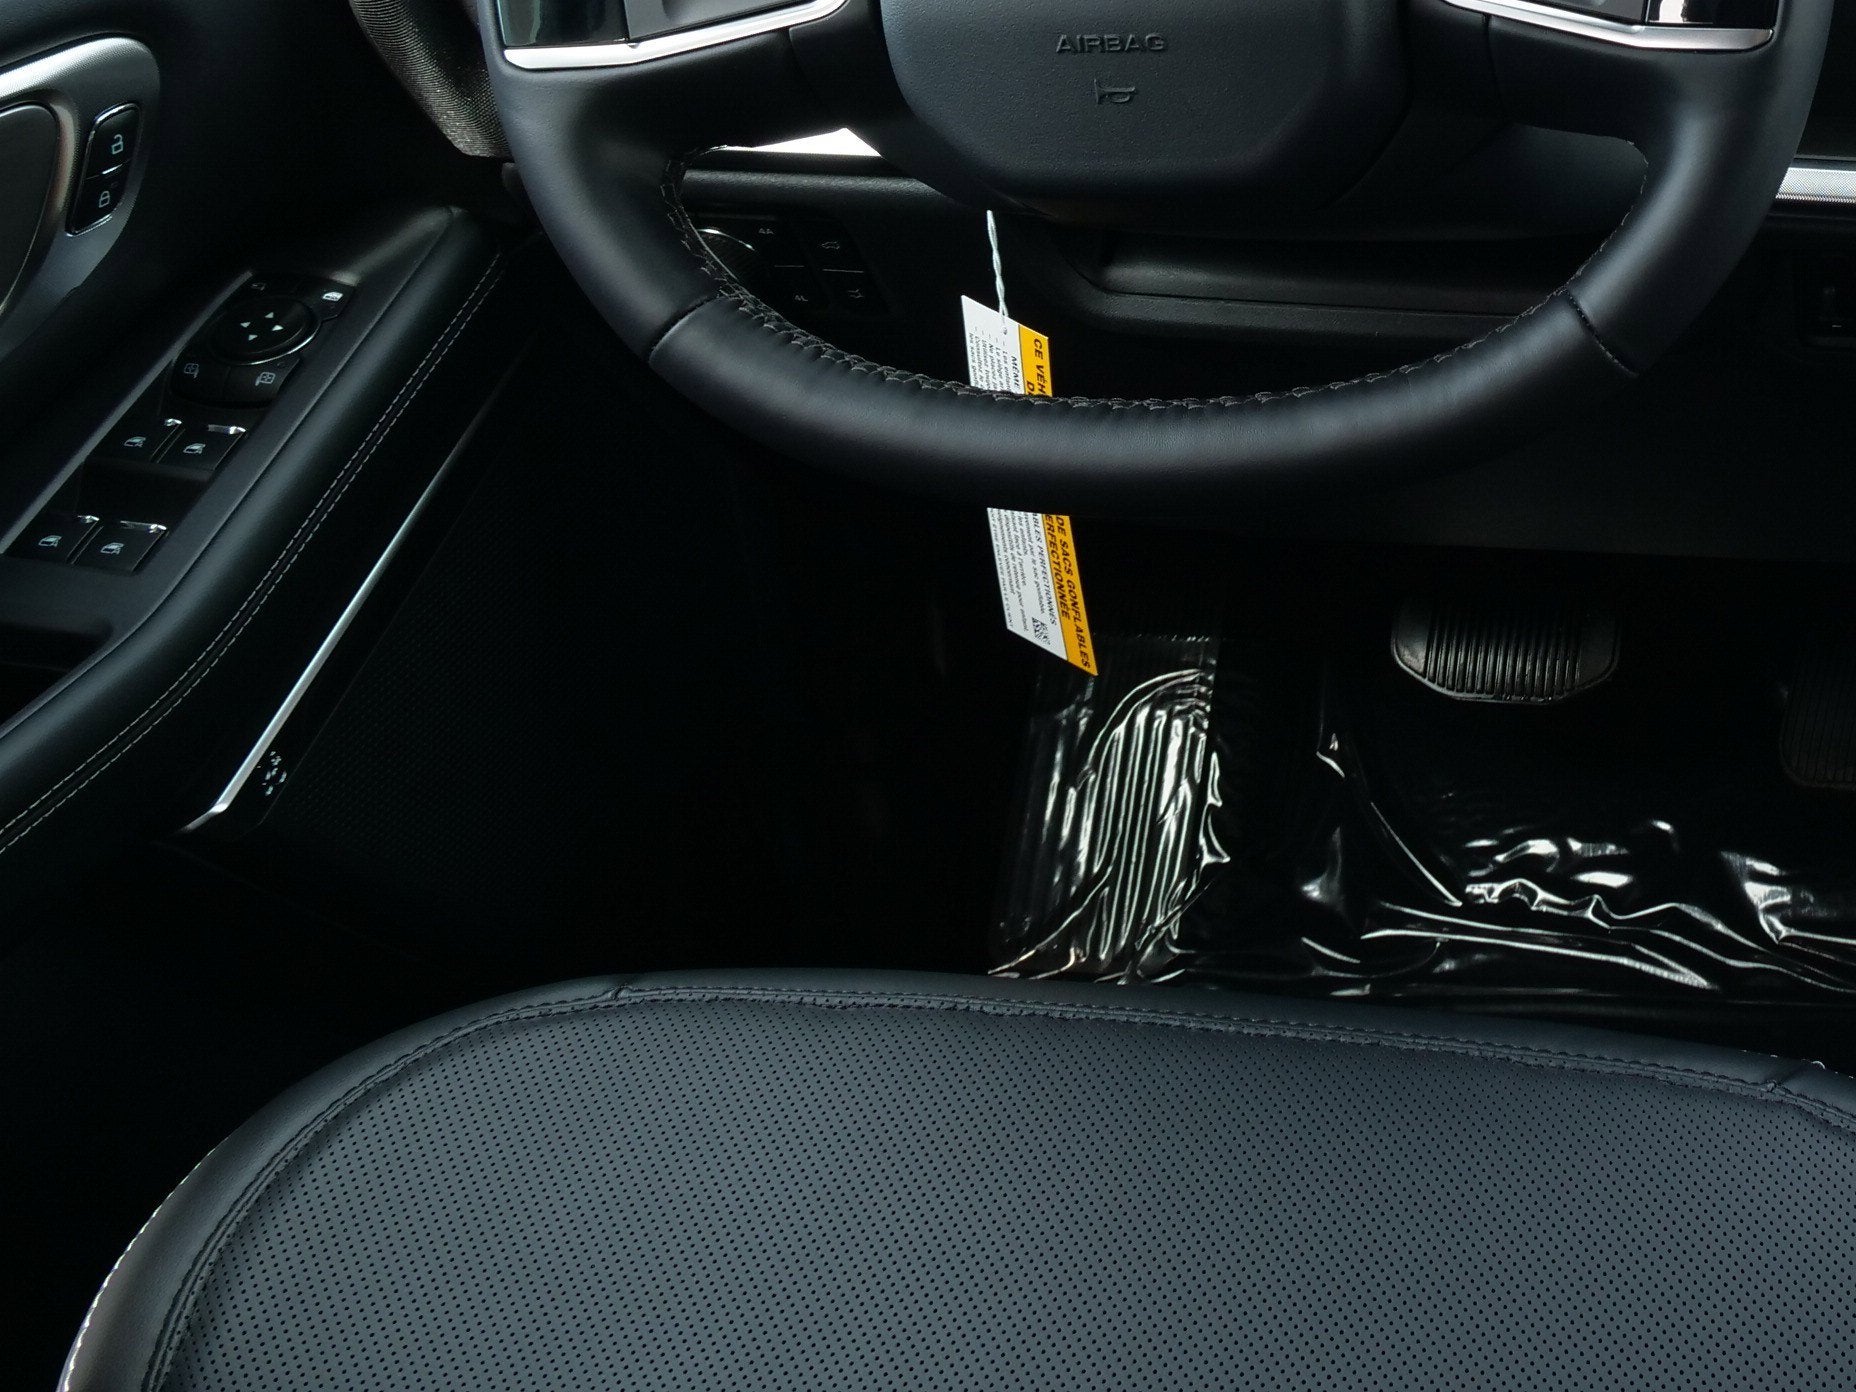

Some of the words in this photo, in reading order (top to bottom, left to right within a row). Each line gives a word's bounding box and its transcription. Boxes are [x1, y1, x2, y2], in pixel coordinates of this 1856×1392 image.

[1055, 33, 1168, 54] AIRBAG
[1034, 338, 1044, 360] CE
[1056, 516, 1067, 536] DE
[1060, 539, 1073, 576] SACS
[1066, 580, 1091, 669] GONFLABLES
